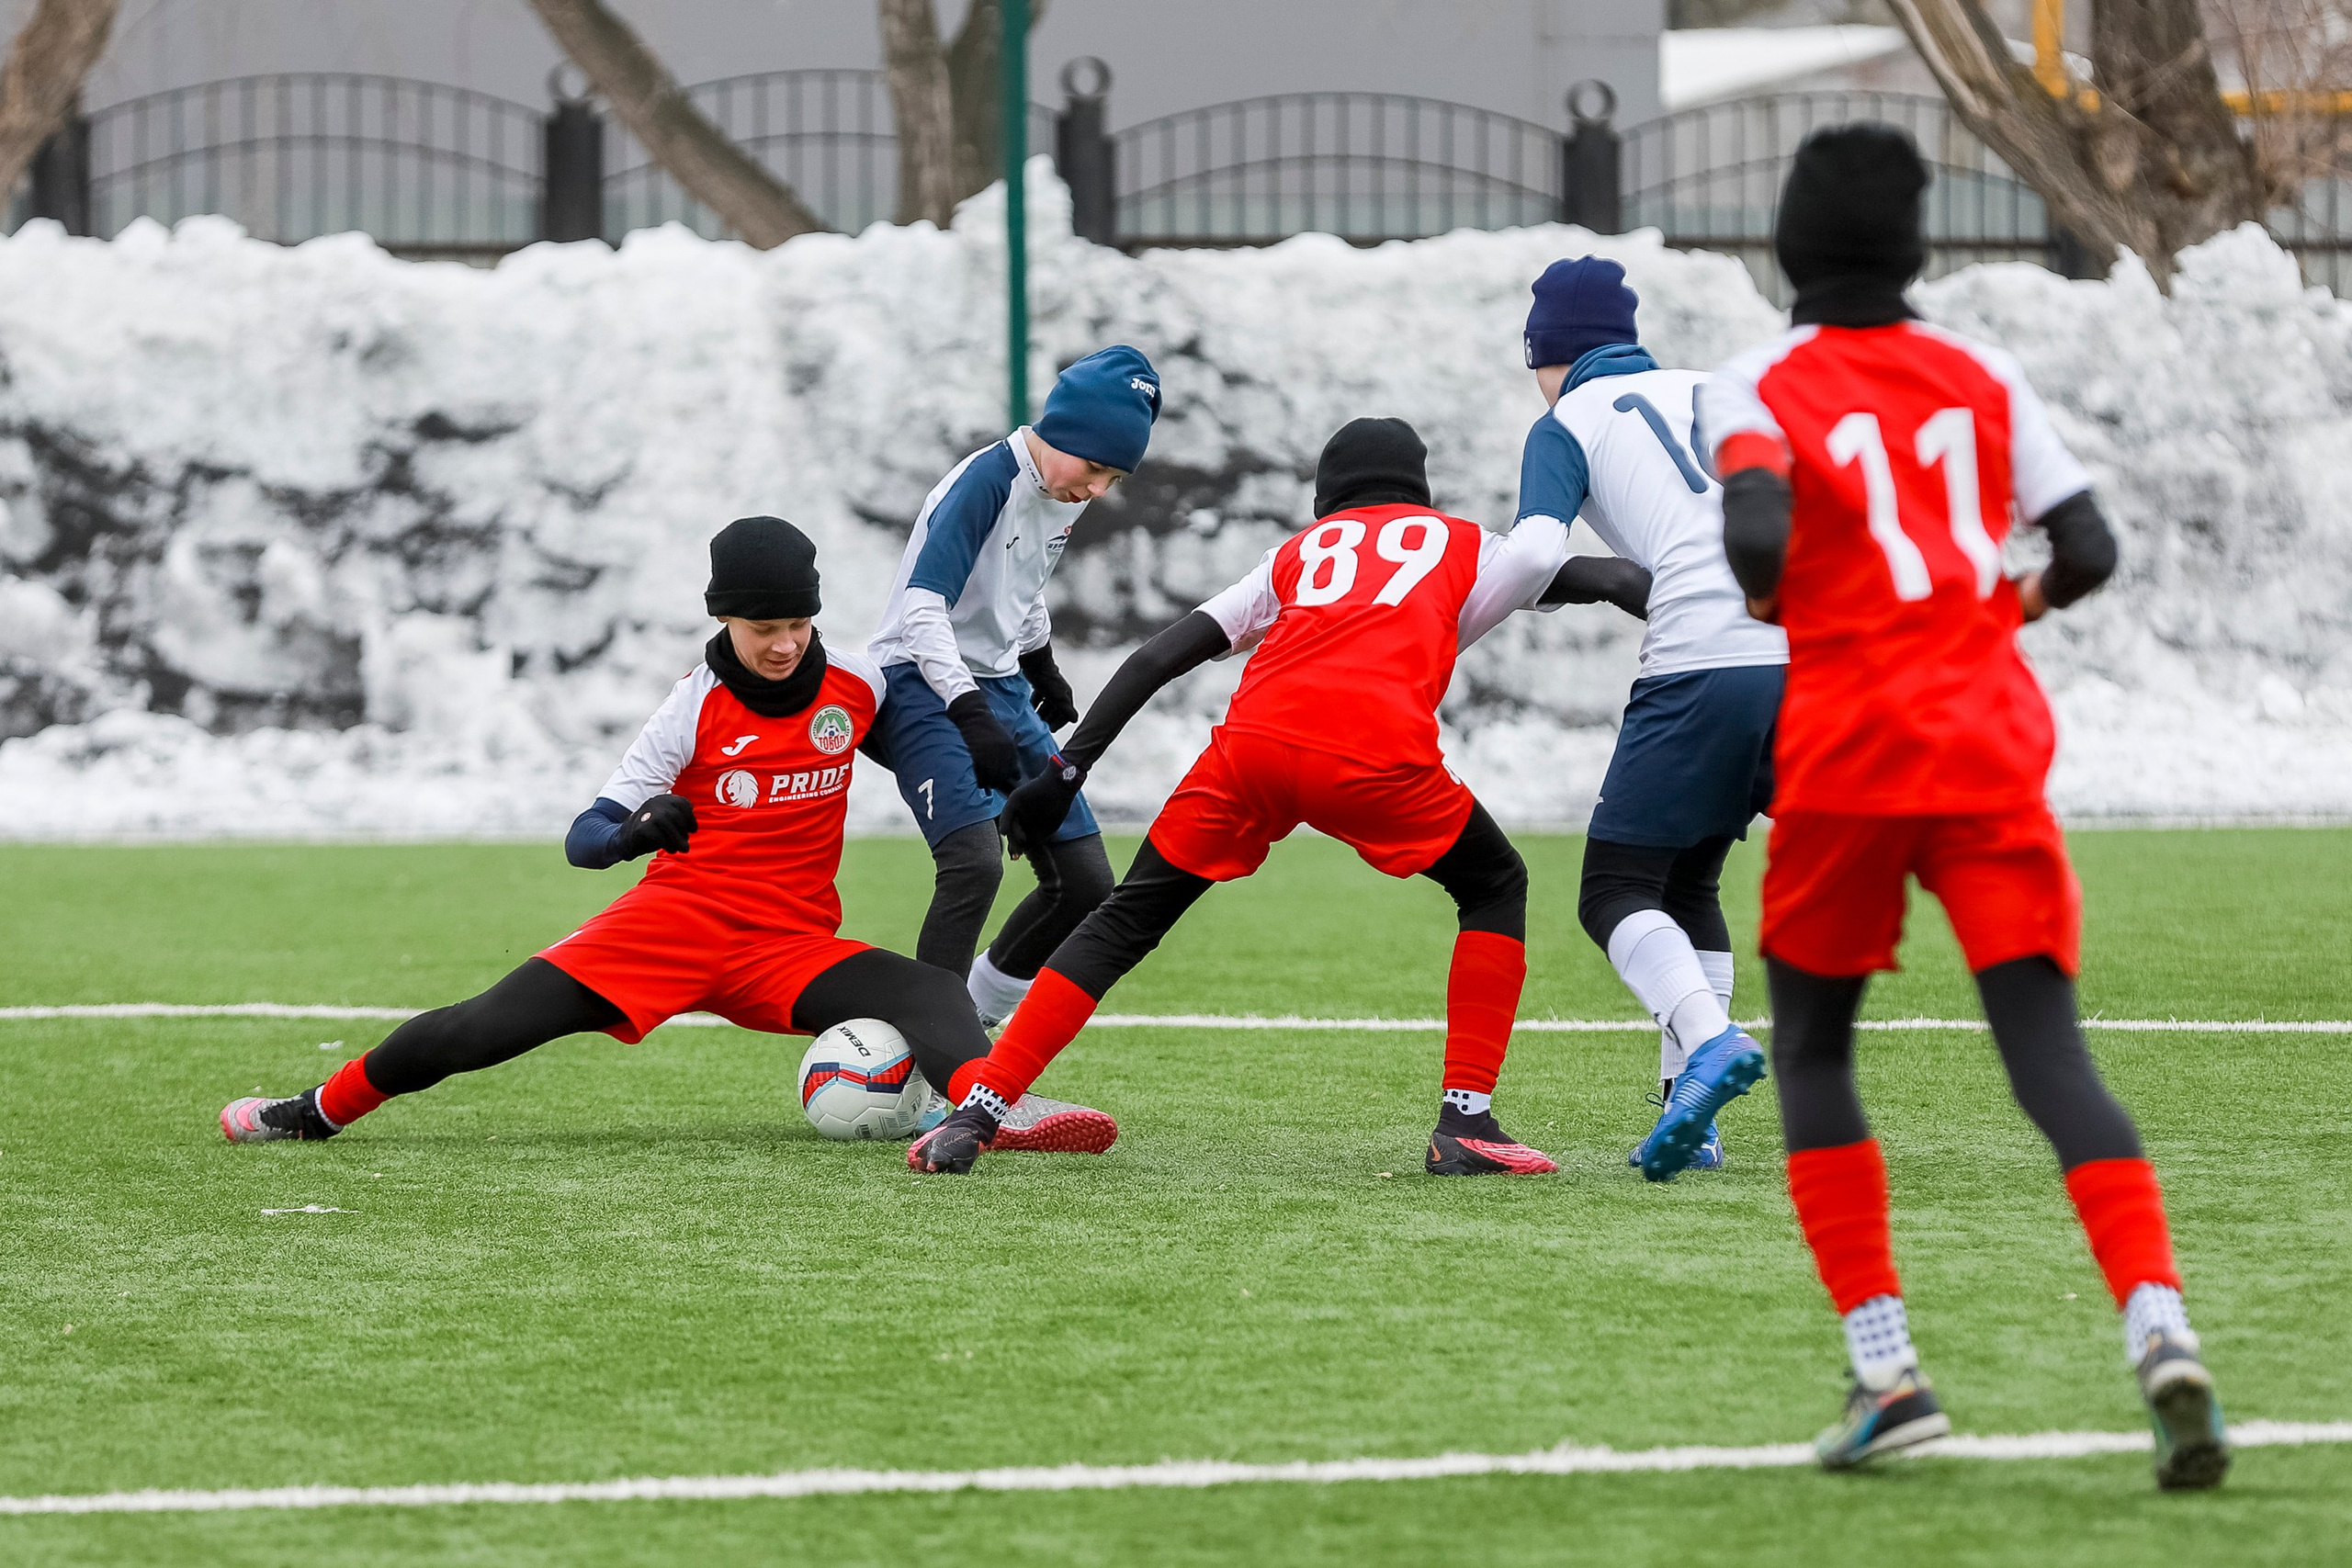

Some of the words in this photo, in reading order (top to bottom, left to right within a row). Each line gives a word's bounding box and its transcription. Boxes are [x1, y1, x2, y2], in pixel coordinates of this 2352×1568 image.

[1131, 378, 1156, 398] Jom
[1825, 406, 2001, 602] 11
[1295, 515, 1450, 607] 89
[818, 735, 846, 751] ТОБОЛ
[770, 762, 850, 795] PRIDE
[768, 791, 819, 803] ENGINEERING
[918, 778, 933, 820] 7
[837, 1026, 872, 1057] DEMIX
